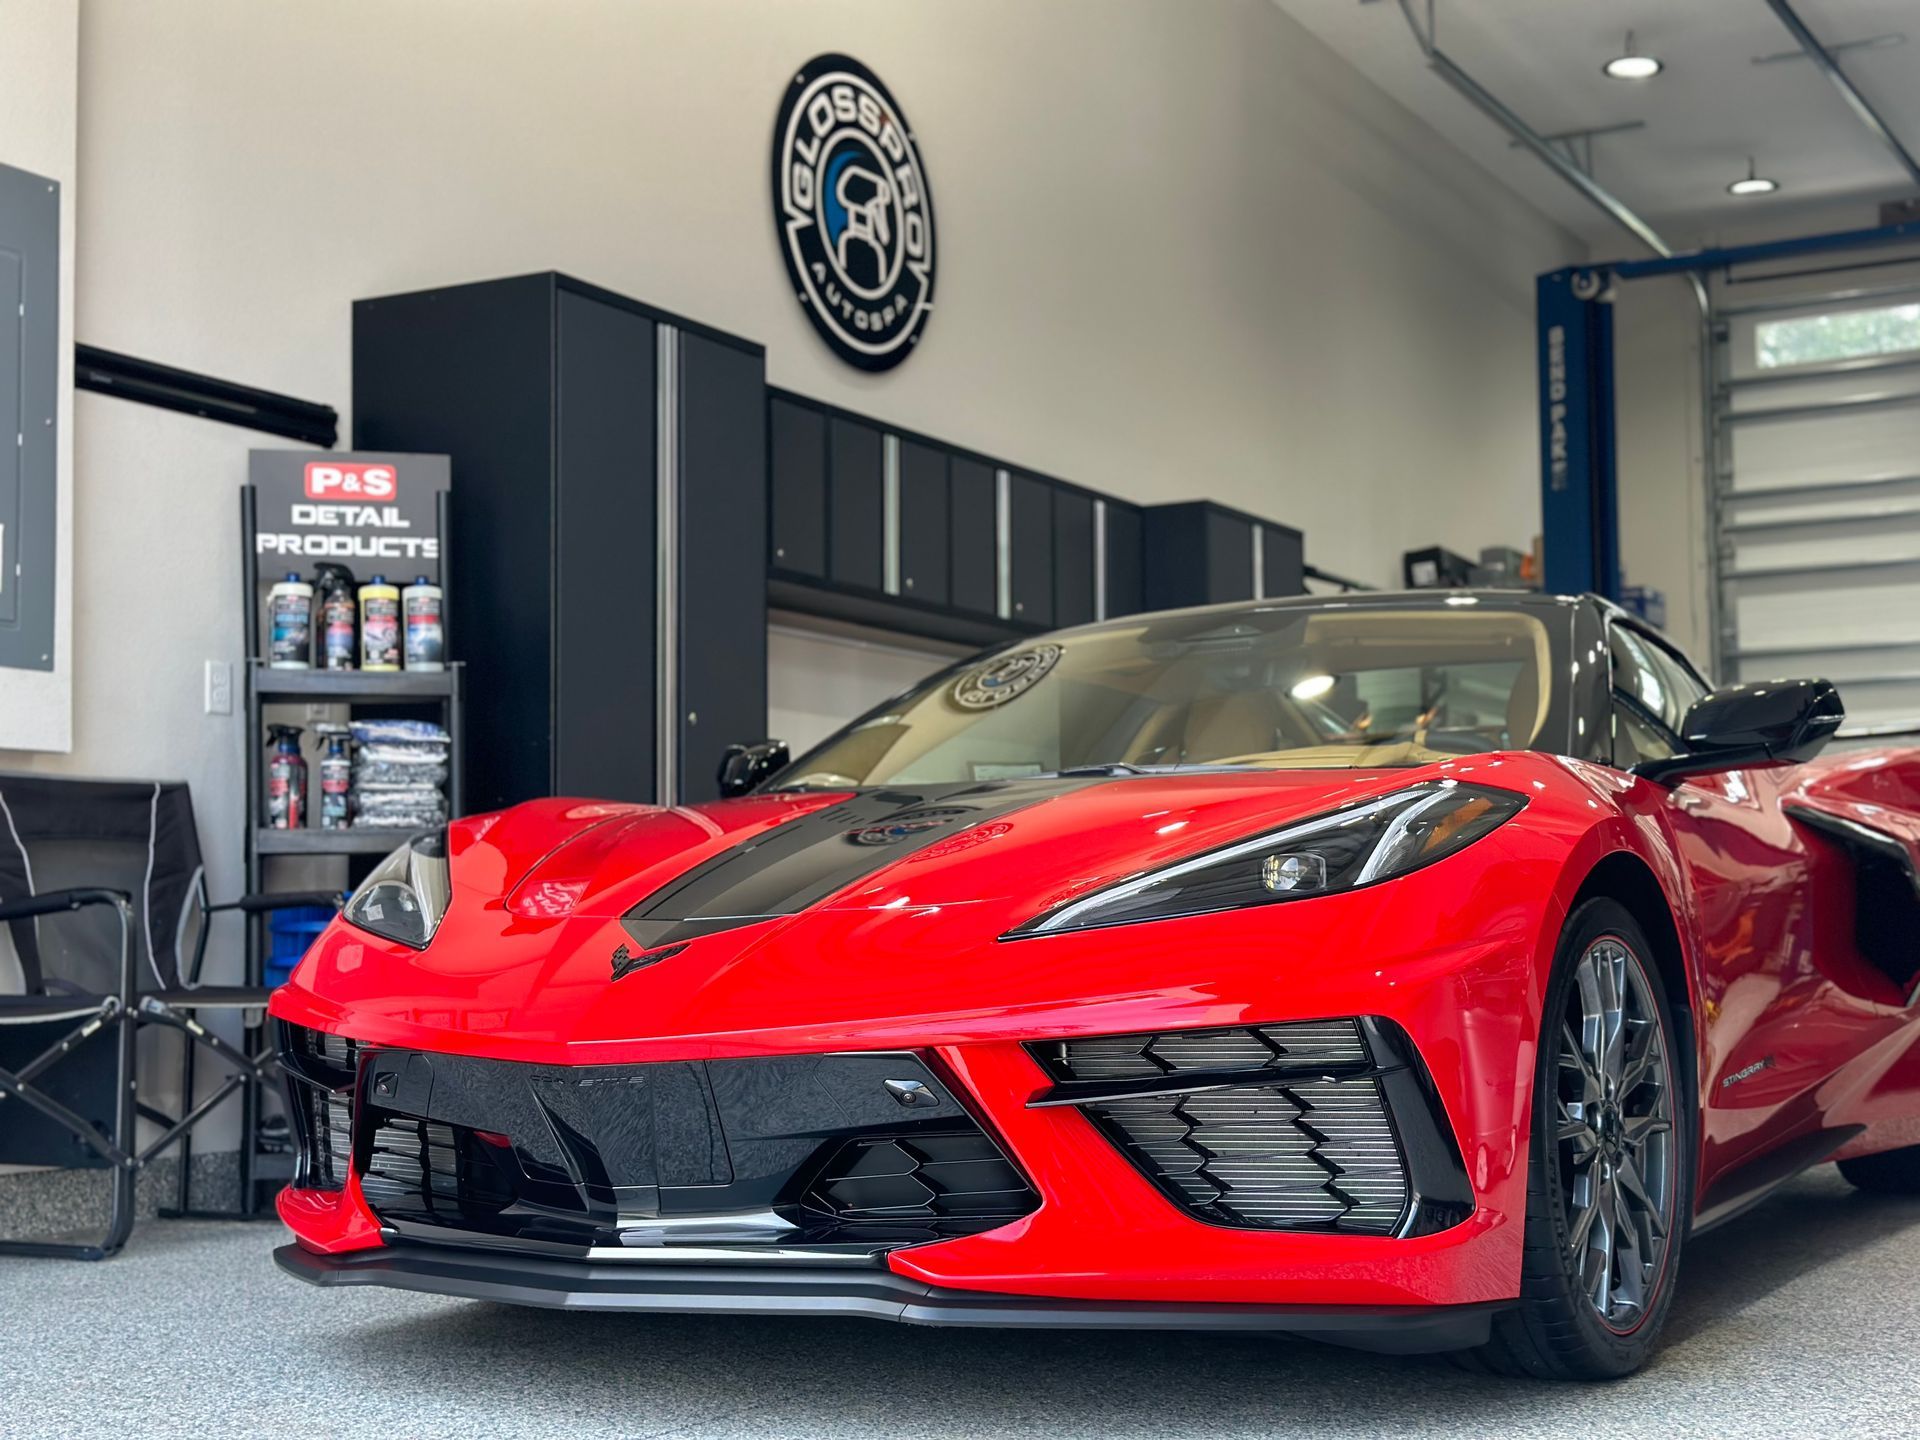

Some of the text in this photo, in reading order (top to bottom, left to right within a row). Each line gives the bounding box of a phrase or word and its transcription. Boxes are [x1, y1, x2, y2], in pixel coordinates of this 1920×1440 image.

[811, 262, 908, 332] AUTOSPA
[311, 467, 393, 495] P&S
[291, 504, 410, 528] DETAIL
[255, 533, 439, 559] PRODUCTS
[1723, 1059, 1766, 1088] STINGRAY
